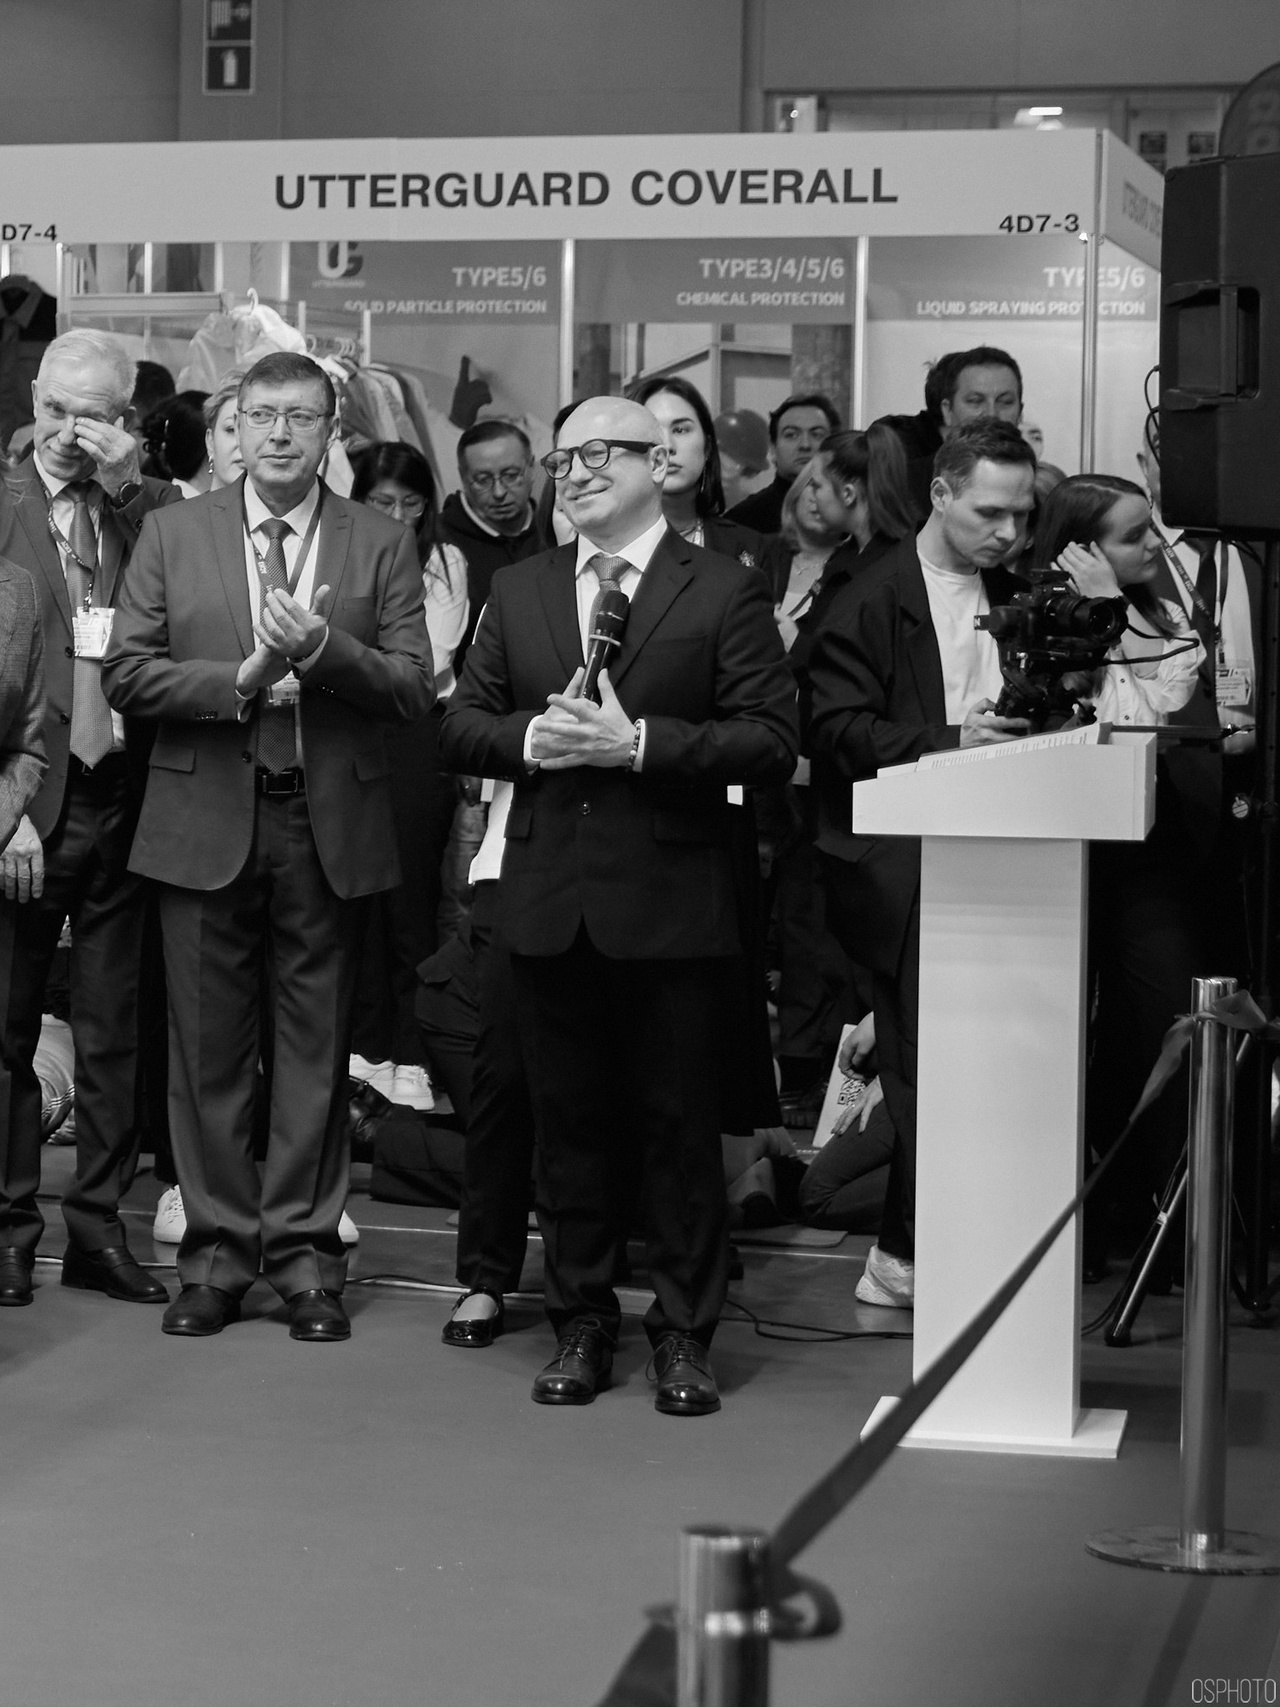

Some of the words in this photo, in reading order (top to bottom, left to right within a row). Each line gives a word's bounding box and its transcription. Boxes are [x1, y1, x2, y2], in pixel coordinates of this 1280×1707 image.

[275, 171, 611, 209] UTTERGUARD
[630, 168, 899, 206] COVERALL
[998, 213, 1080, 233] 4D7-3
[452, 266, 547, 290] TYPE5/6
[698, 256, 845, 283] TYPE3/4/5/6
[386, 300, 453, 314] PARTICLE
[456, 300, 547, 314] PROTECTION
[676, 291, 749, 306] CHEMICAL
[751, 291, 845, 306] PROTECTION
[917, 301, 966, 317] LIQUID
[968, 301, 1046, 316] SPRAYING
[1048, 300, 1146, 316] PROCTION
